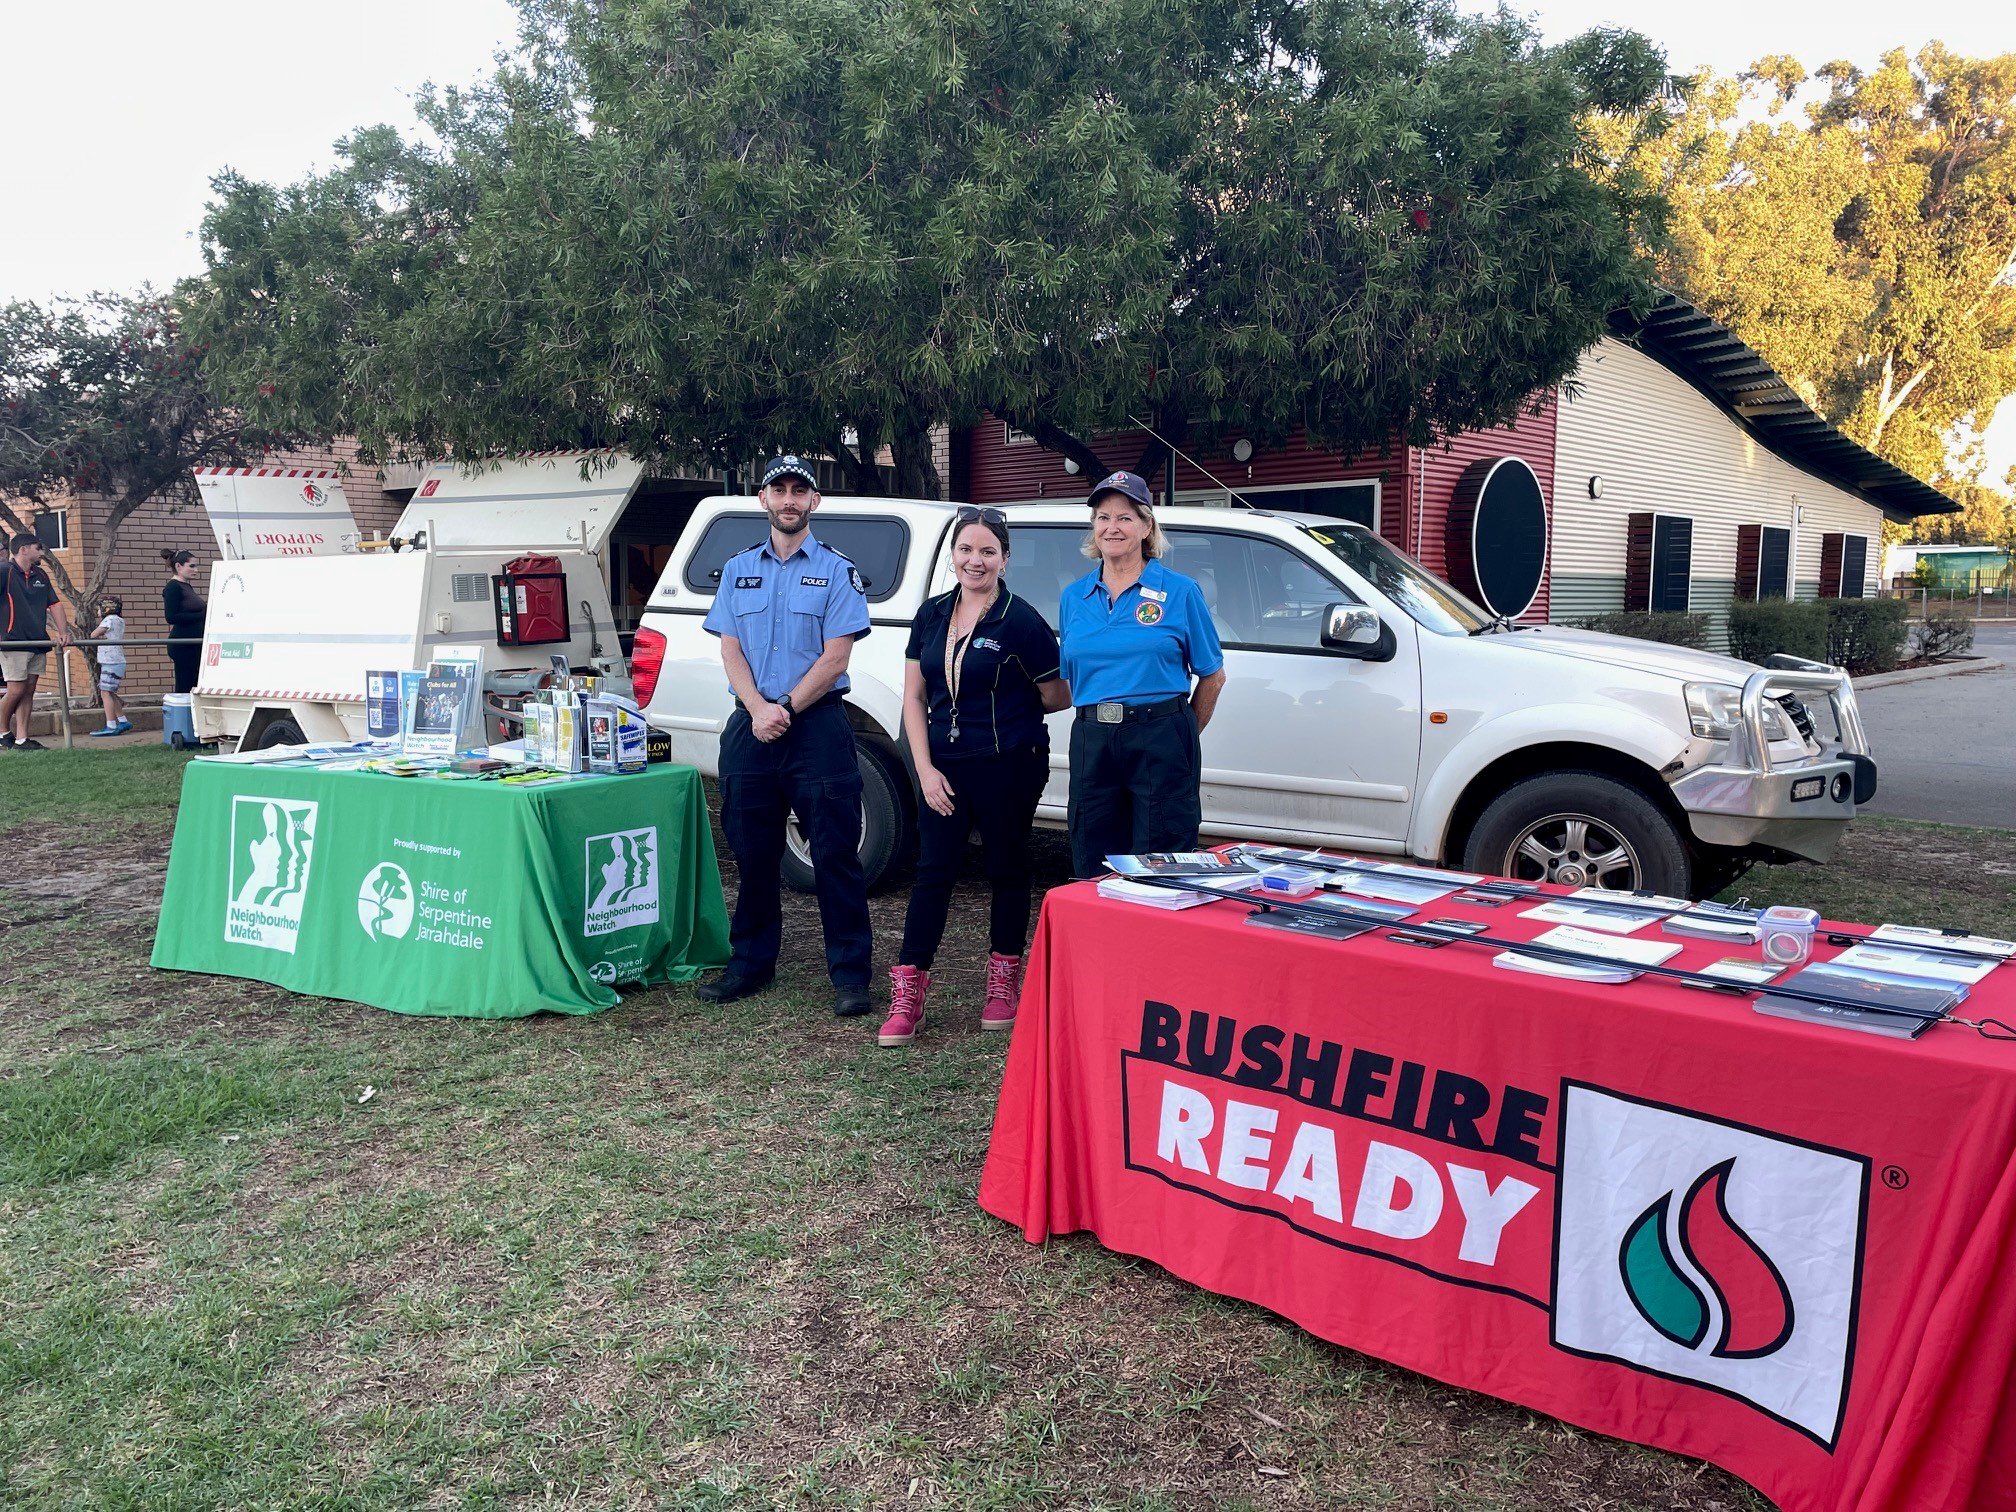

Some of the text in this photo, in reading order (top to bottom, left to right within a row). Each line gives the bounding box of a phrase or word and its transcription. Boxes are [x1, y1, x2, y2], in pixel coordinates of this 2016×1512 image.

[255, 533, 324, 545] SUPPORT
[802, 578, 828, 586] POLICE
[221, 649, 240, 657] First Aid
[407, 735, 453, 743] Neighbourhood
[393, 838, 461, 859] Proudly supported by
[420, 880, 468, 905] Shire of
[419, 901, 492, 929] Serpentine
[587, 900, 657, 922] Neighbourhood
[229, 923, 263, 941] Watch
[415, 922, 484, 950] Jarrahdale
[587, 921, 616, 933] Watch
[617, 957, 643, 970] Shire of
[1140, 1000, 1550, 1166] BUSHFIRE
[1157, 1080, 1541, 1267] READY
